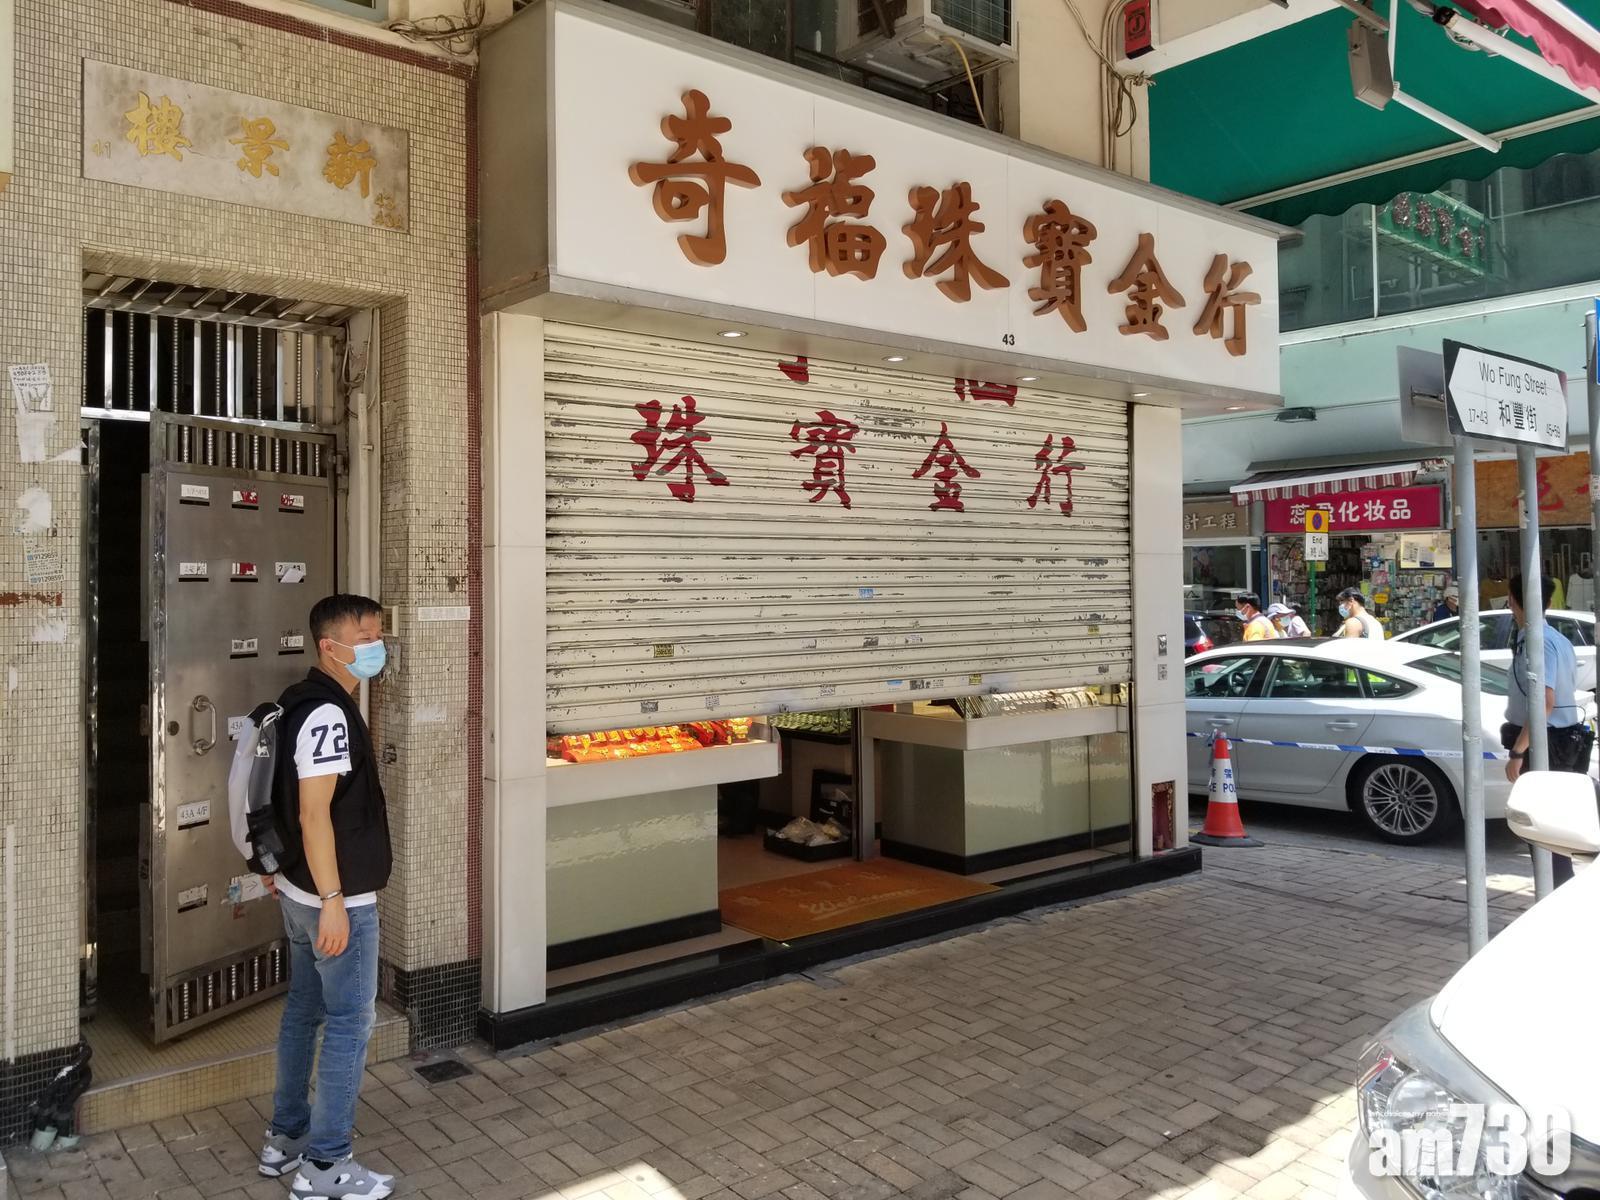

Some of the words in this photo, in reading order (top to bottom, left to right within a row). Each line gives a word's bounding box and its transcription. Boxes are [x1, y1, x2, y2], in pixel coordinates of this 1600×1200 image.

[628, 89, 1261, 357] 奇福珠寶金行
[1002, 333, 1015, 346] 43
[1479, 361, 1496, 383] Wo
[1499, 367, 1522, 394] Fung
[1524, 373, 1548, 396] Street
[1498, 400, 1538, 432] 和豐街
[1184, 512, 1237, 530] 計工程
[1312, 535, 1323, 544] End
[311, 723, 348, 758] 72
